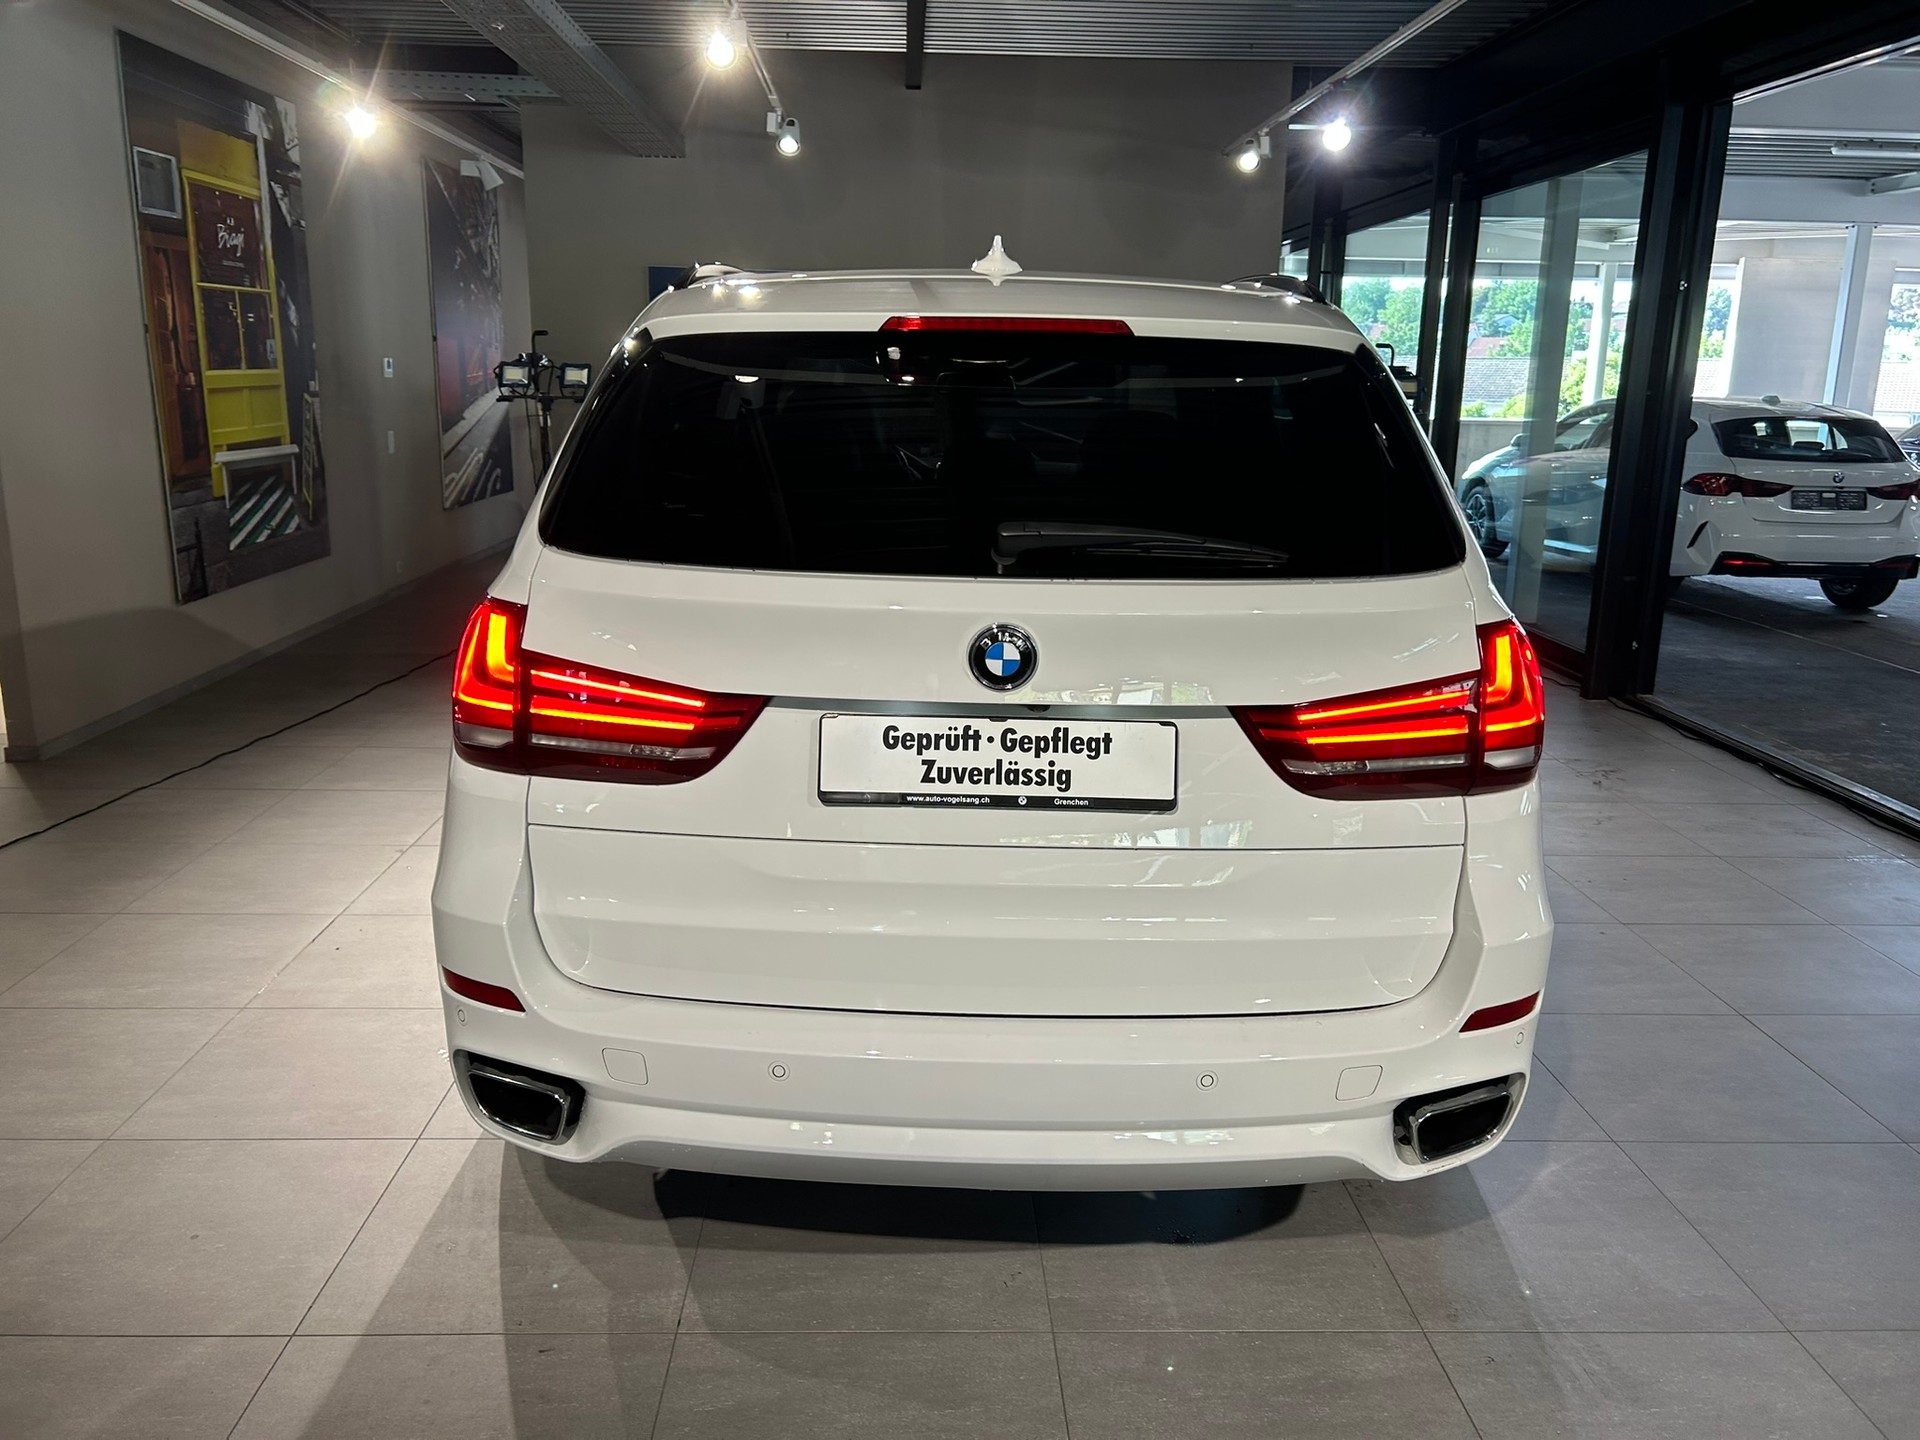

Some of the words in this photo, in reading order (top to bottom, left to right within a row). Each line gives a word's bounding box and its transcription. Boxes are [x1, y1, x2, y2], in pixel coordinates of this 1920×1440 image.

[883, 725, 981, 756] Geprüft
[1000, 727, 1113, 760] Gepflegt
[920, 758, 1072, 792] Zuverlässig
[906, 795, 990, 805] www.auto-vogelsang.ch
[1053, 797, 1089, 806] Grenchen
